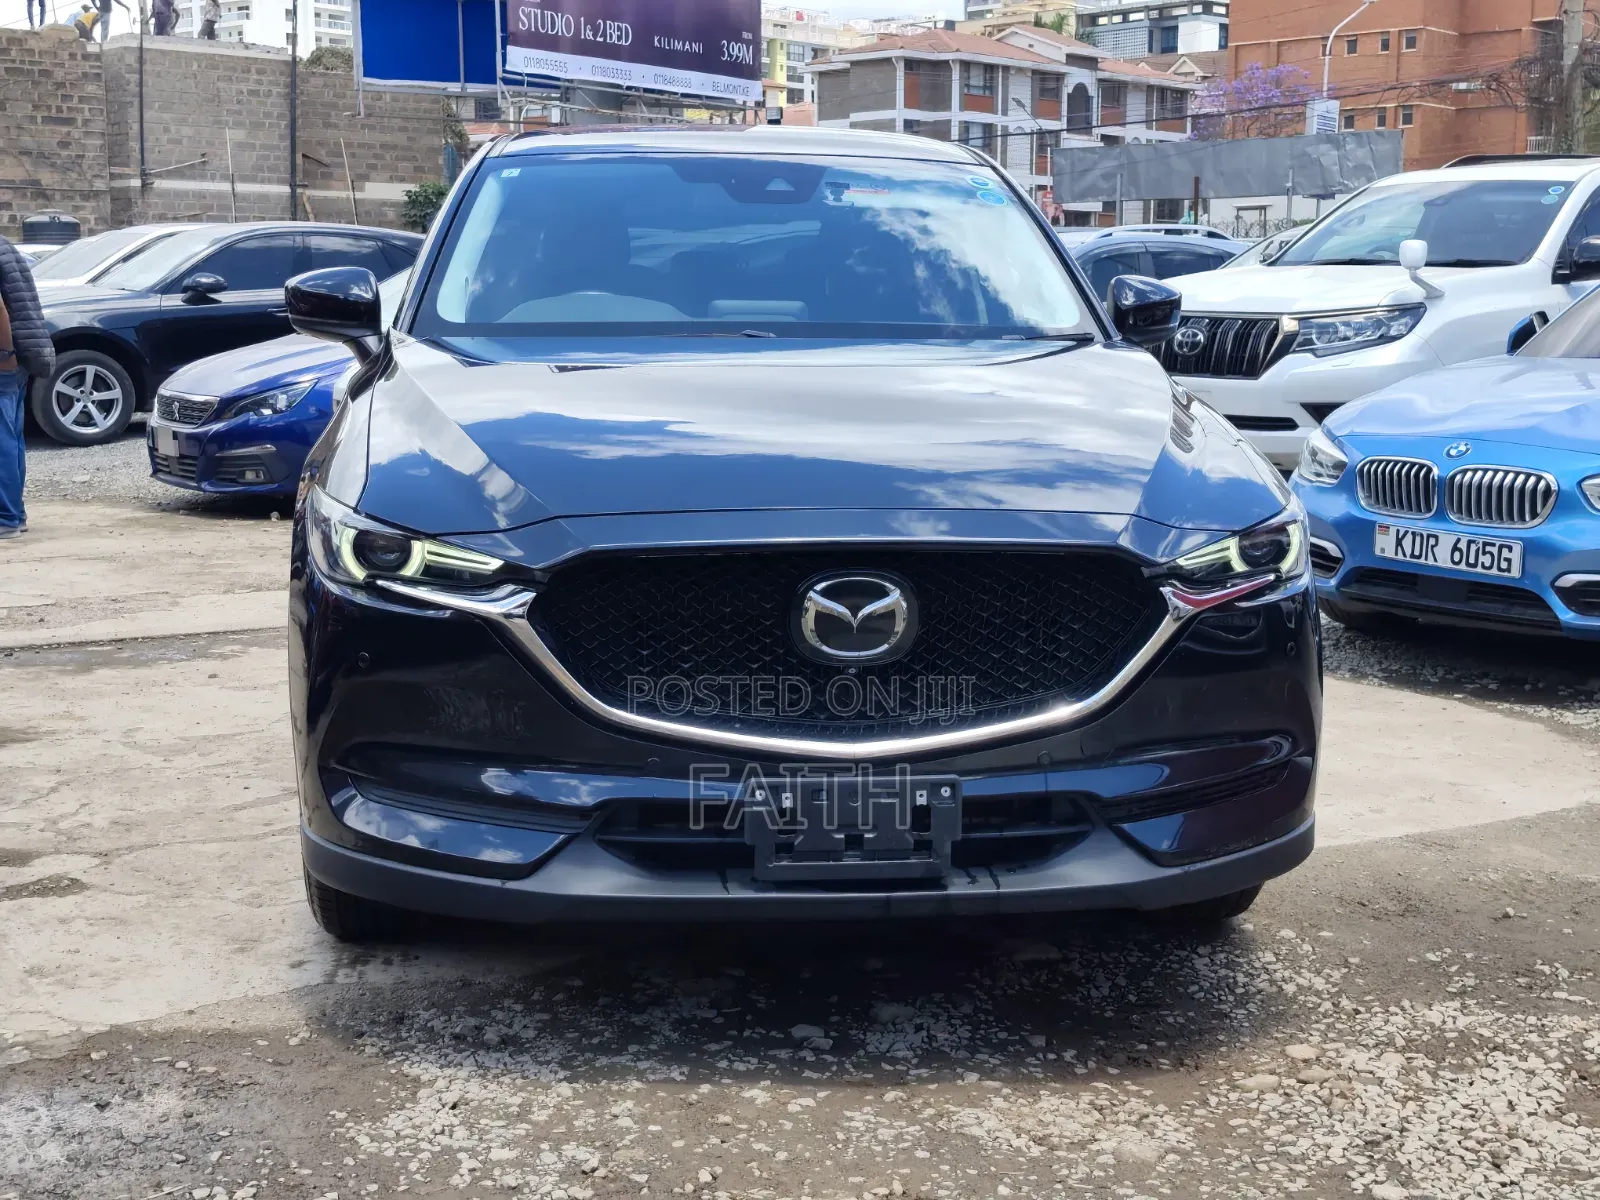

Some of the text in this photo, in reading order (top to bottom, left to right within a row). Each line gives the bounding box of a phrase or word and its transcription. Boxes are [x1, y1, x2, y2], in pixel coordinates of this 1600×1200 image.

[519, 6, 575, 37] STUDIO
[606, 20, 632, 46] BED
[654, 35, 703, 54] KILIMANI
[720, 40, 753, 65] 3.99M
[523, 56, 568, 74] 0118055555
[591, 64, 632, 81] 0118033333
[712, 81, 750, 97] BELMONT.KE
[1394, 528, 1513, 574] KDR 605G
